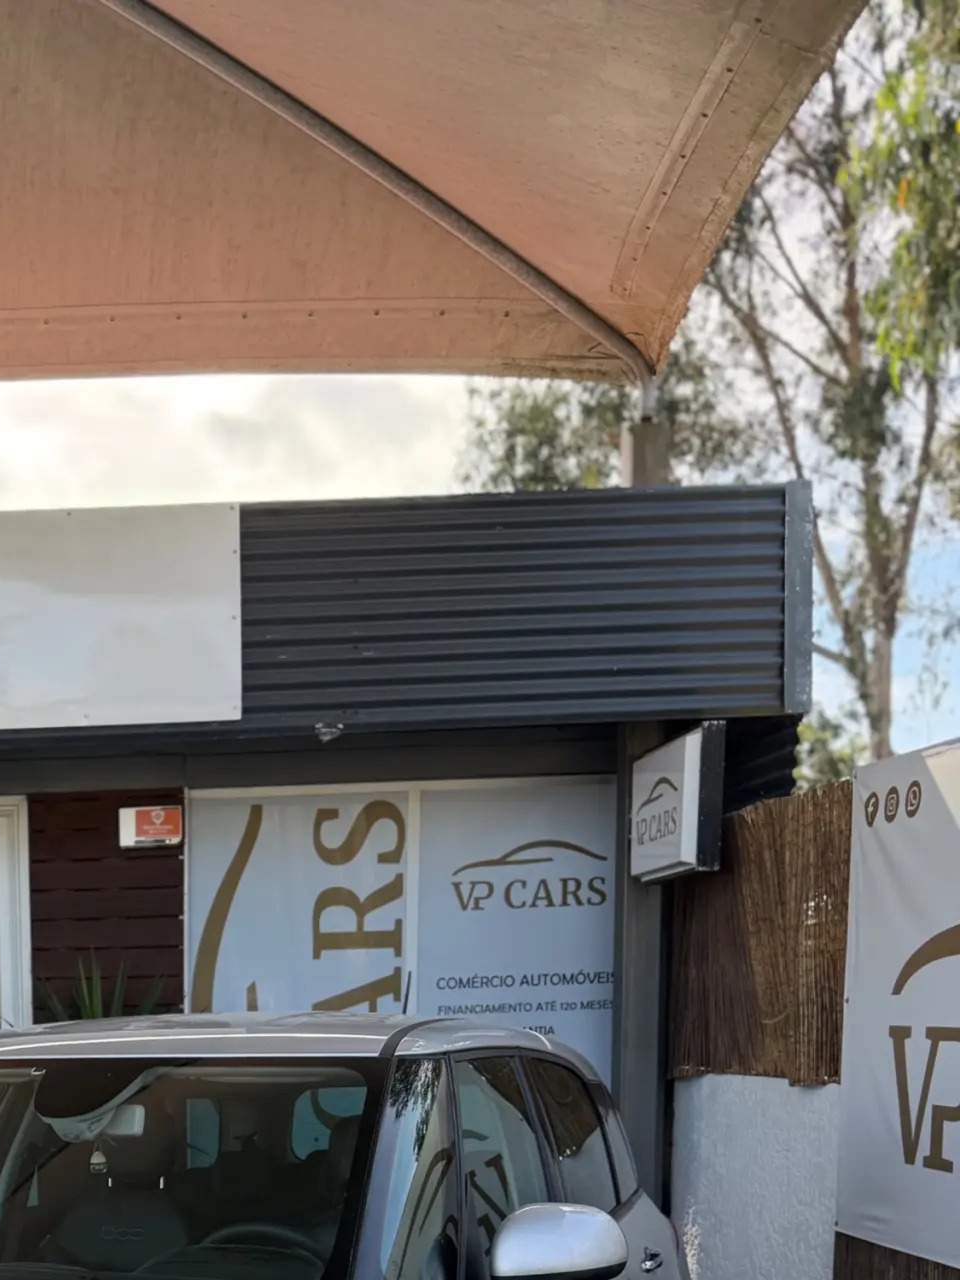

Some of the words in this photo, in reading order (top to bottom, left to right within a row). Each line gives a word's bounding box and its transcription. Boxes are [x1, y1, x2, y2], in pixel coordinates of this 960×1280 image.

[648, 806, 678, 842] CARS
[312, 799, 406, 1013] ARS
[451, 881, 494, 911] VP
[504, 876, 608, 909] CARS
[436, 973, 516, 990] COMÉRCIO
[437, 1002, 533, 1016] FINANCIAMENTO
[535, 1000, 557, 1012] ATÉ
[560, 1002, 578, 1011] 120
